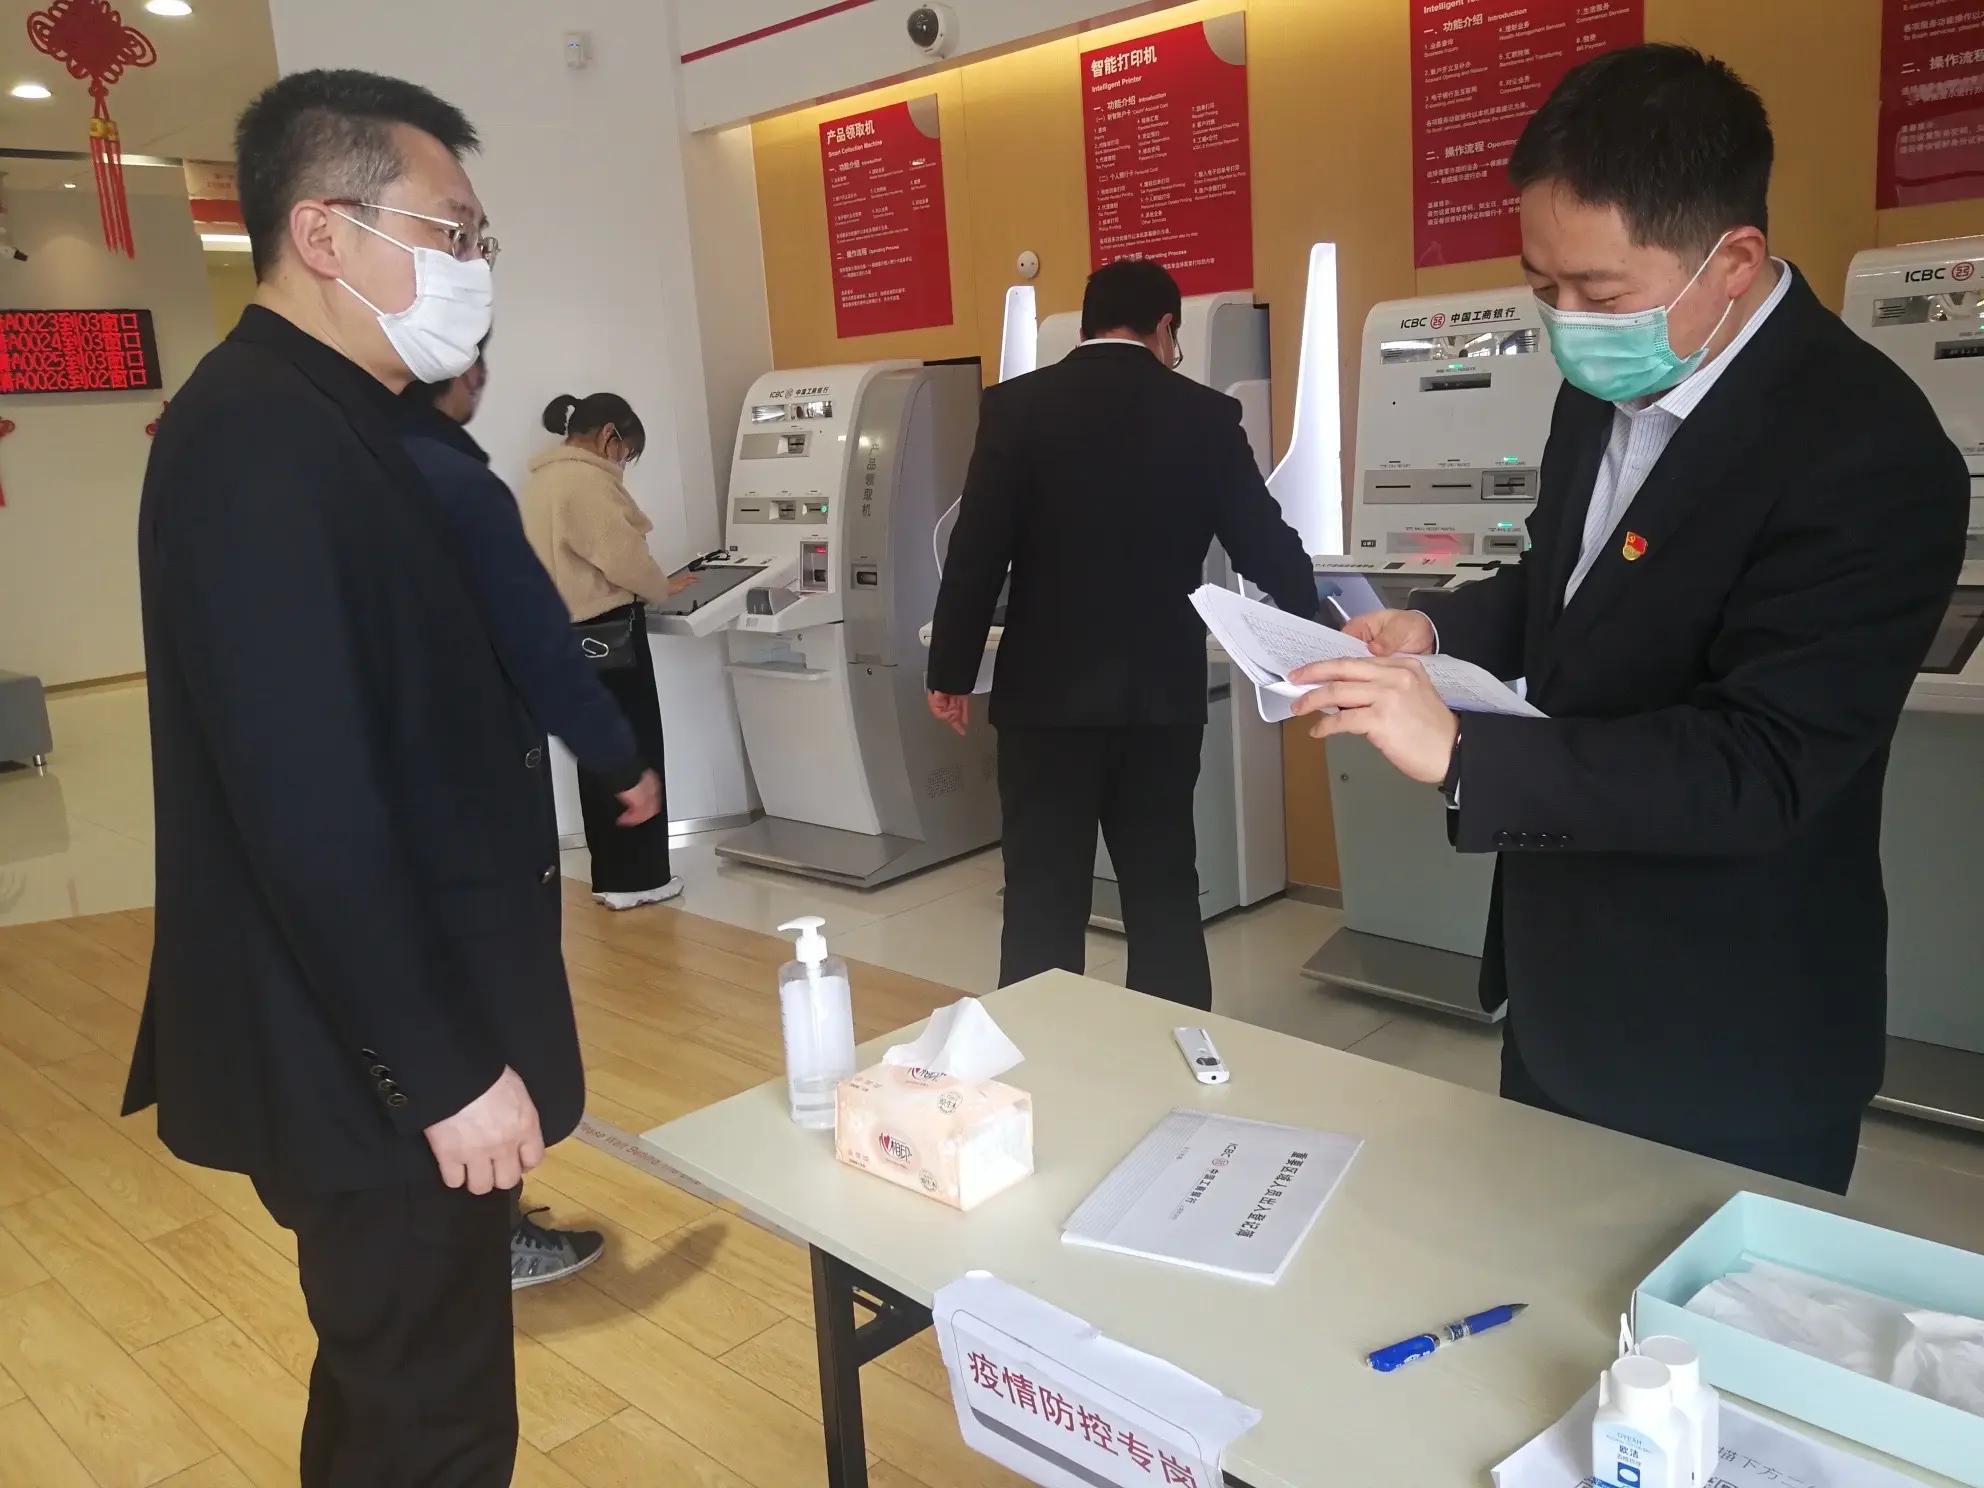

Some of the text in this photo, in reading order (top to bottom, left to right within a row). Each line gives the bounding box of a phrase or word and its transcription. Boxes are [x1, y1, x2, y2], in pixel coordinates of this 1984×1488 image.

[1488, 8, 1527, 22] Introduction
[1091, 45, 1157, 78] 智能打印机
[1091, 75, 1143, 93] Intelligent Printer
[826, 119, 875, 145] 产品领取机
[1905, 267, 1946, 283] ICBC
[1400, 307, 1516, 329] ICBC 中国工商银行
[1185, 1168, 1219, 1205] 中国工商银行
[1234, 1151, 1308, 1240] 重要区域人员出入登记簿
[967, 1351, 1199, 1488] 疫情防控专岗
